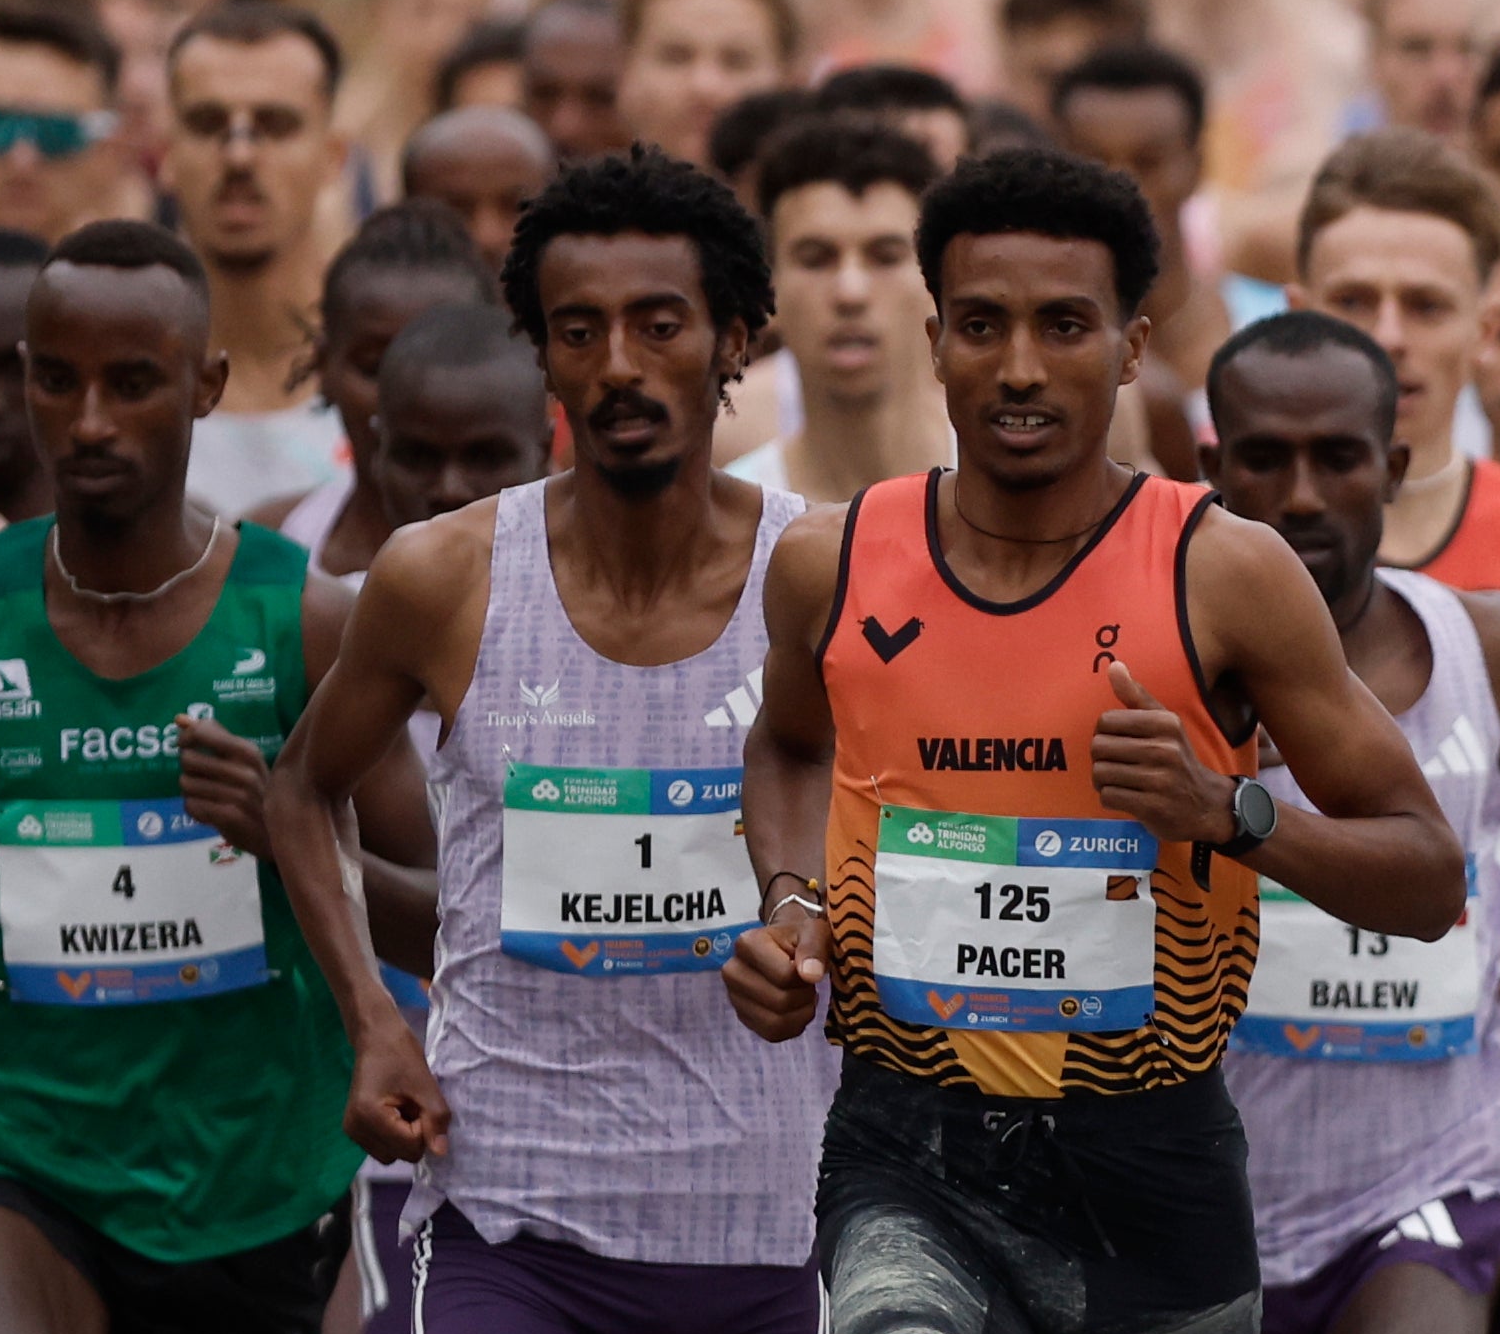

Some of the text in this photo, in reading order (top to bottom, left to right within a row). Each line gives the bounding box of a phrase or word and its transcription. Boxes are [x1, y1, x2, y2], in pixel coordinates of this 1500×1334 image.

[487, 709, 596, 729] Tirop's Angels
[917, 738, 1068, 772] VALENCIA
[564, 785, 618, 795] TRINIDAD
[564, 795, 617, 806] ALFONSO
[635, 833, 652, 868] 1
[937, 829, 986, 844] TRINIDAD
[937, 839, 986, 853] ALFONSO
[1069, 836, 1138, 853] ZURICH
[112, 865, 136, 899] 4
[561, 887, 726, 923] KEJELCHA
[974, 882, 1051, 923] 125
[59, 918, 203, 953] KWIZERA
[957, 943, 1066, 979] PACER
[1310, 980, 1419, 1009] BALEW
